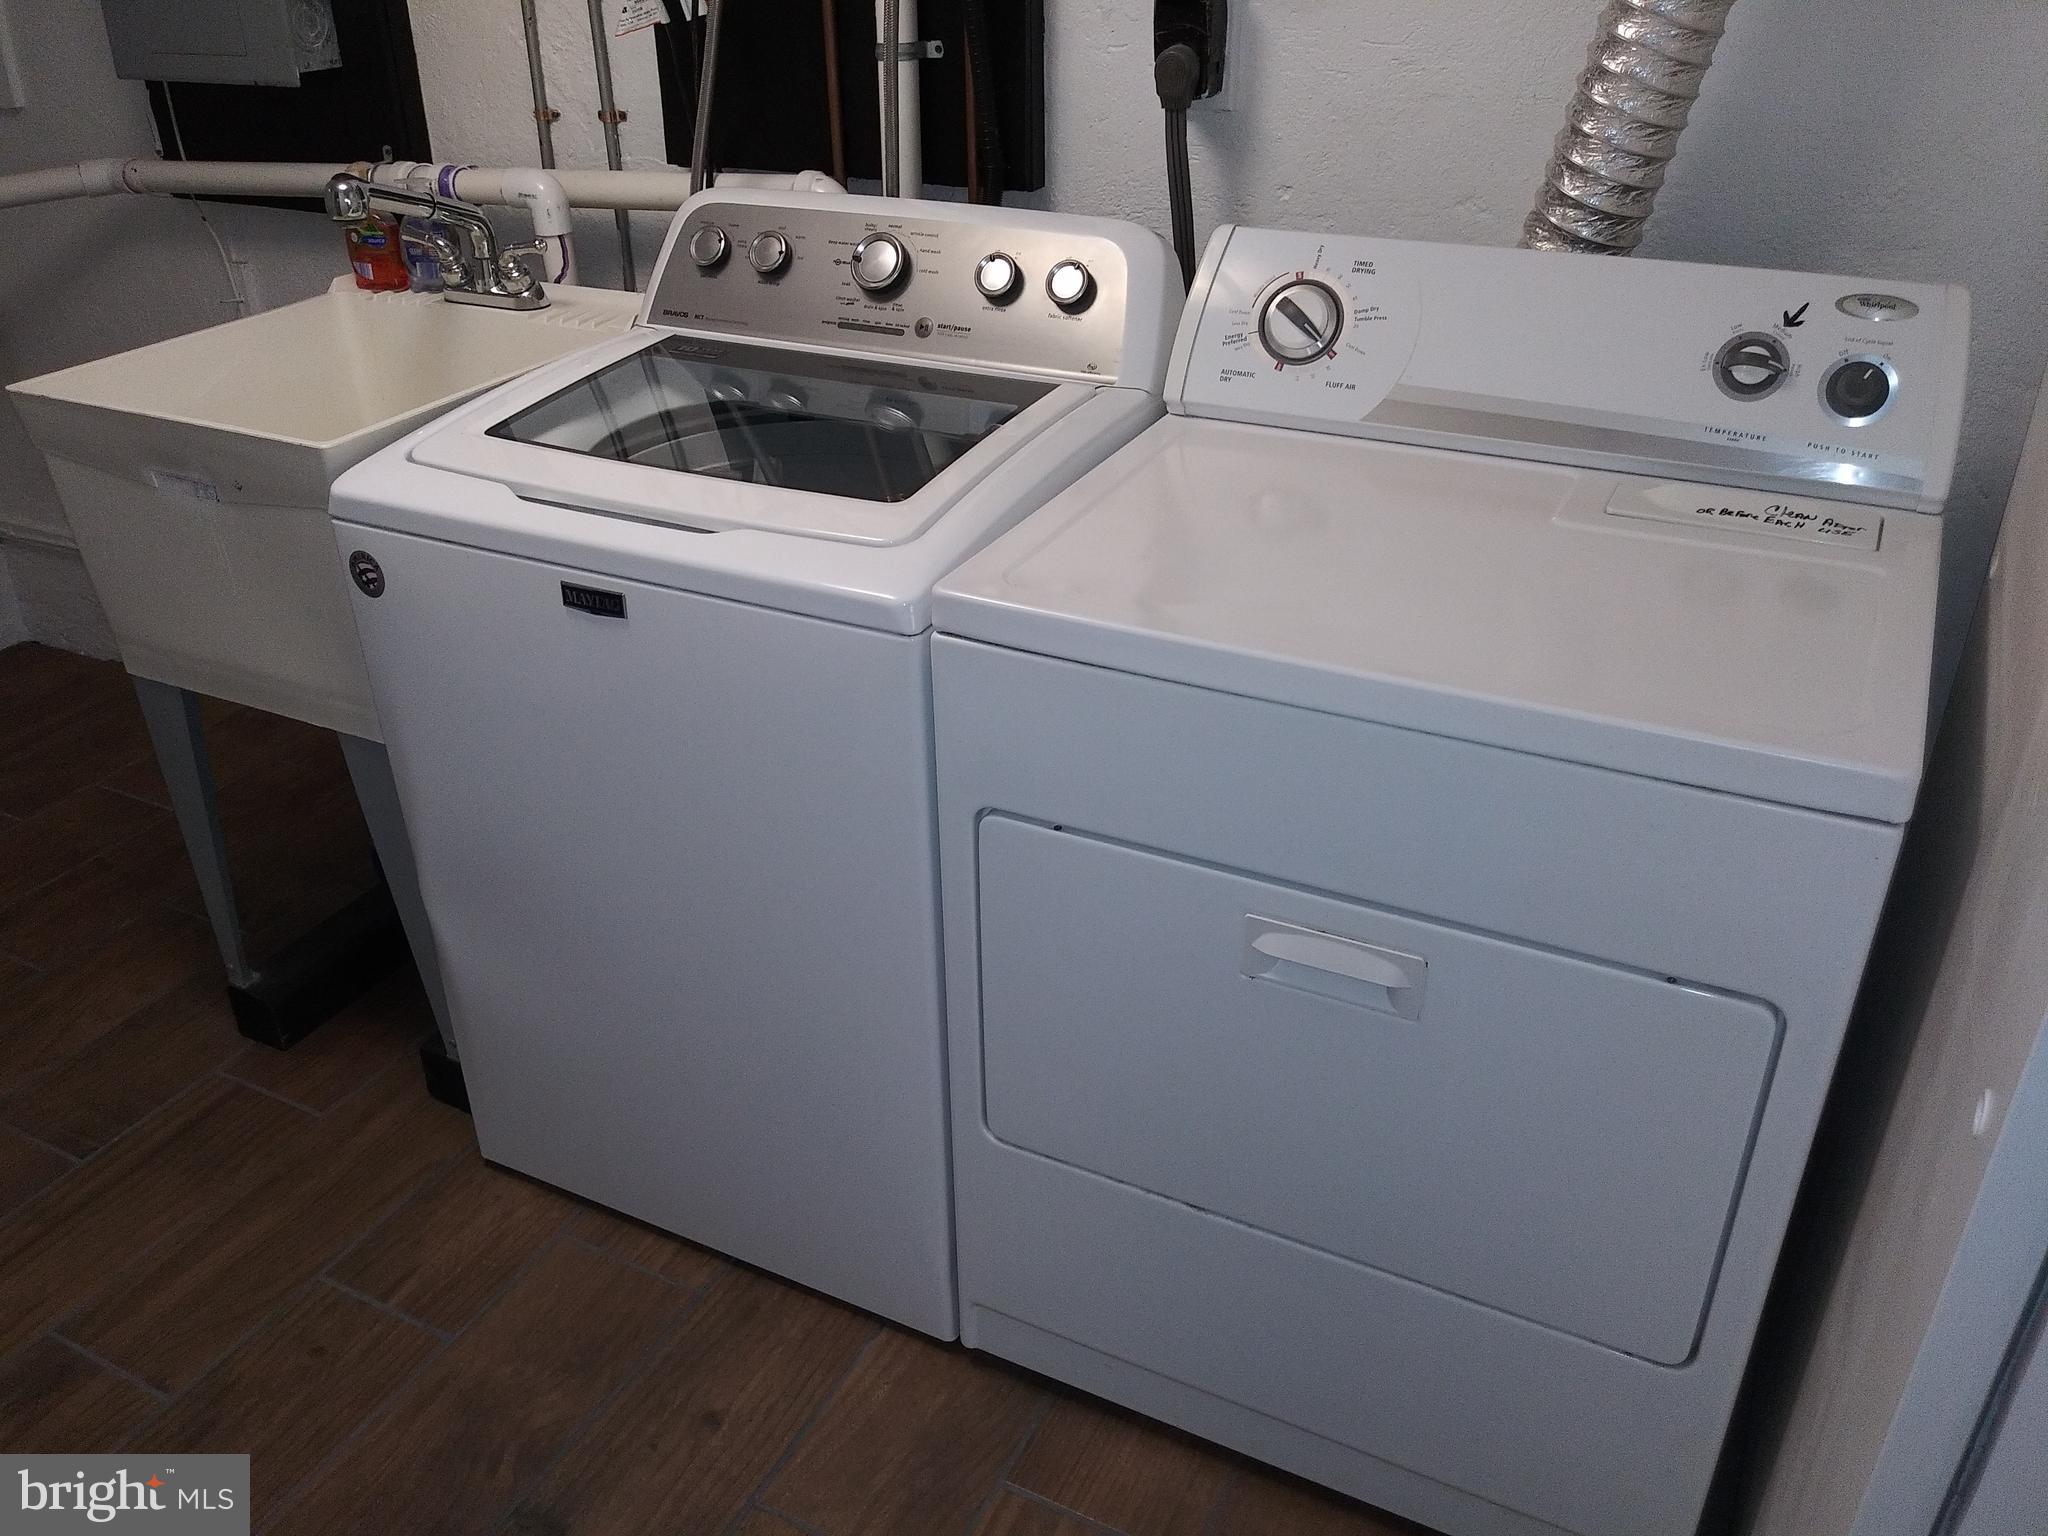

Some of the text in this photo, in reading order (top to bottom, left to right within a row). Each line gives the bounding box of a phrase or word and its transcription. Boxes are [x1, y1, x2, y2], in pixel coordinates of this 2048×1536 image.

[1353, 260, 1374, 268] TIMED
[1351, 267, 1376, 275] DRYING
[1369, 306, 1380, 314] Dry
[1858, 300, 1898, 312] Whirlpool
[937, 322, 972, 333] start/pause
[1222, 336, 1248, 347] Preferred
[1224, 332, 1244, 341] Energy
[1220, 368, 1257, 379] AUTOMATIC
[1219, 376, 1233, 384] DRY
[1325, 381, 1357, 391] FLUFF AIR
[1703, 425, 1768, 442] TEMPERATURE
[1806, 441, 1880, 461] PUSH TO START
